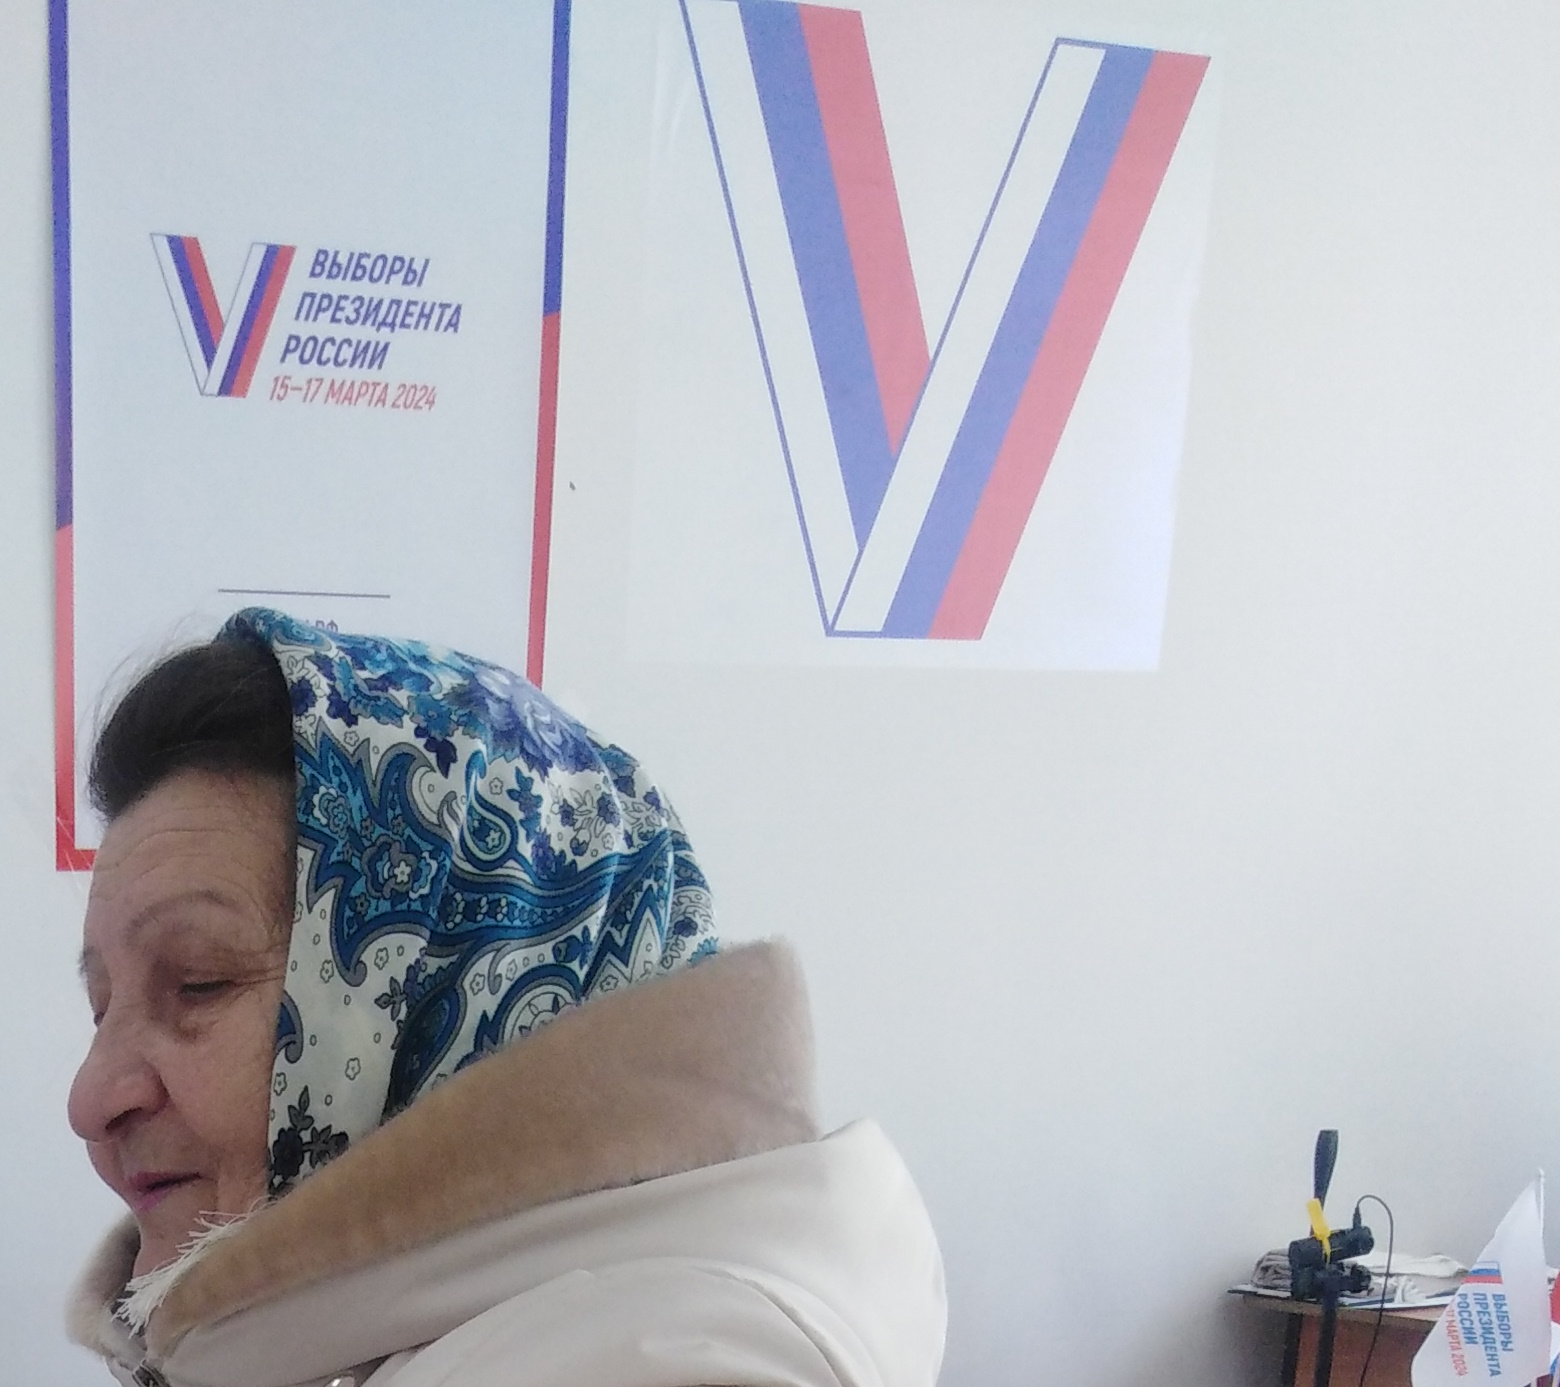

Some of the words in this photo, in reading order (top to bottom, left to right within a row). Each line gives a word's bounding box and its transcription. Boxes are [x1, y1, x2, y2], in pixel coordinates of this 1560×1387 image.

[309, 249, 430, 287] ВЫБОРЫ
[294, 292, 463, 333] ПРЕЗИДЕНТА
[280, 334, 390, 370] РОССИИ
[327, 380, 389, 408] МАРТА
[391, 384, 437, 411] 2024
[1473, 1292, 1501, 1377] ПРЕЗИДЕНТА
[1492, 1293, 1514, 1352] ВЫБОРЫ
